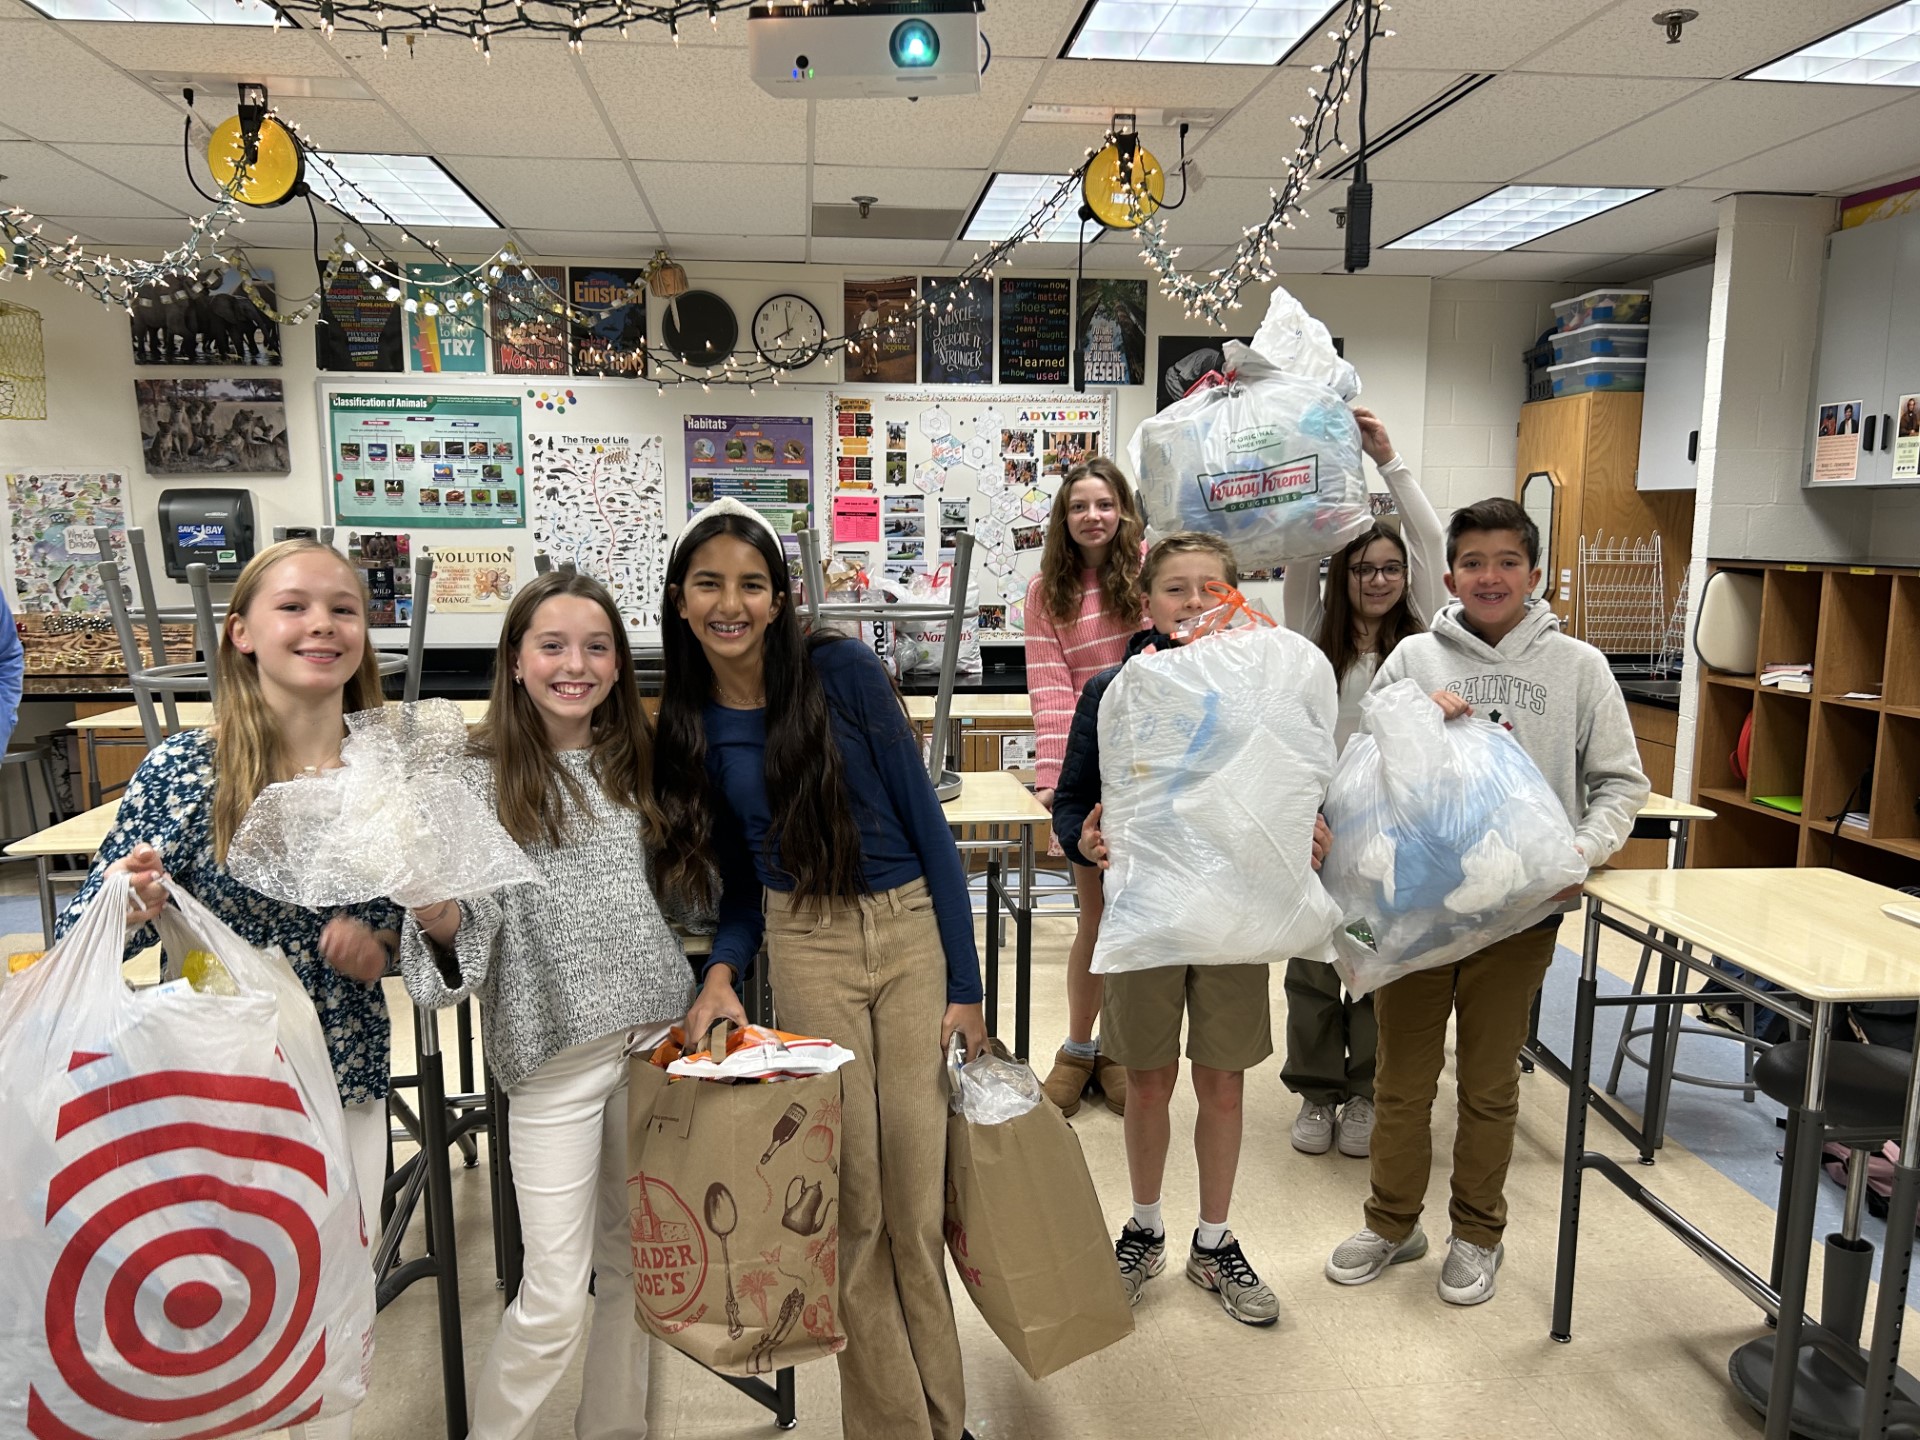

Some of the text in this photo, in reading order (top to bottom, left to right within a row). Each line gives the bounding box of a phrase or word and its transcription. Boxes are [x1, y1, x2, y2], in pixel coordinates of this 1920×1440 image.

[1002, 281, 1014, 293] 30
[1038, 293, 1068, 301] matter
[1014, 302, 1046, 312] shoes
[1024, 315, 1044, 324] hair
[1014, 324, 1036, 334] jeans
[1036, 332, 1068, 340] bought.
[441, 339, 475, 356] TRY.
[1022, 340, 1038, 348] will
[1019, 356, 1065, 367] learned
[1036, 371, 1060, 380] used
[1084, 362, 1126, 381] RESENT
[334, 397, 386, 406] Classification
[387, 398, 395, 407] of
[396, 398, 427, 408] Animals
[1020, 411, 1098, 421] ADVISORY
[688, 418, 727, 430] Habitats
[562, 436, 629, 445] The Tree of Life
[1238, 430, 1274, 442] ORIGINAL
[1210, 466, 1311, 502] Krispy Kreme
[1230, 494, 1297, 510] DOUGHNUTS
[206, 526, 223, 534] BAY
[68, 540, 96, 550] Biology
[1446, 675, 1546, 715] SAINTS
[632, 1245, 697, 1269] RADER
[638, 1272, 686, 1296] JOE'S
